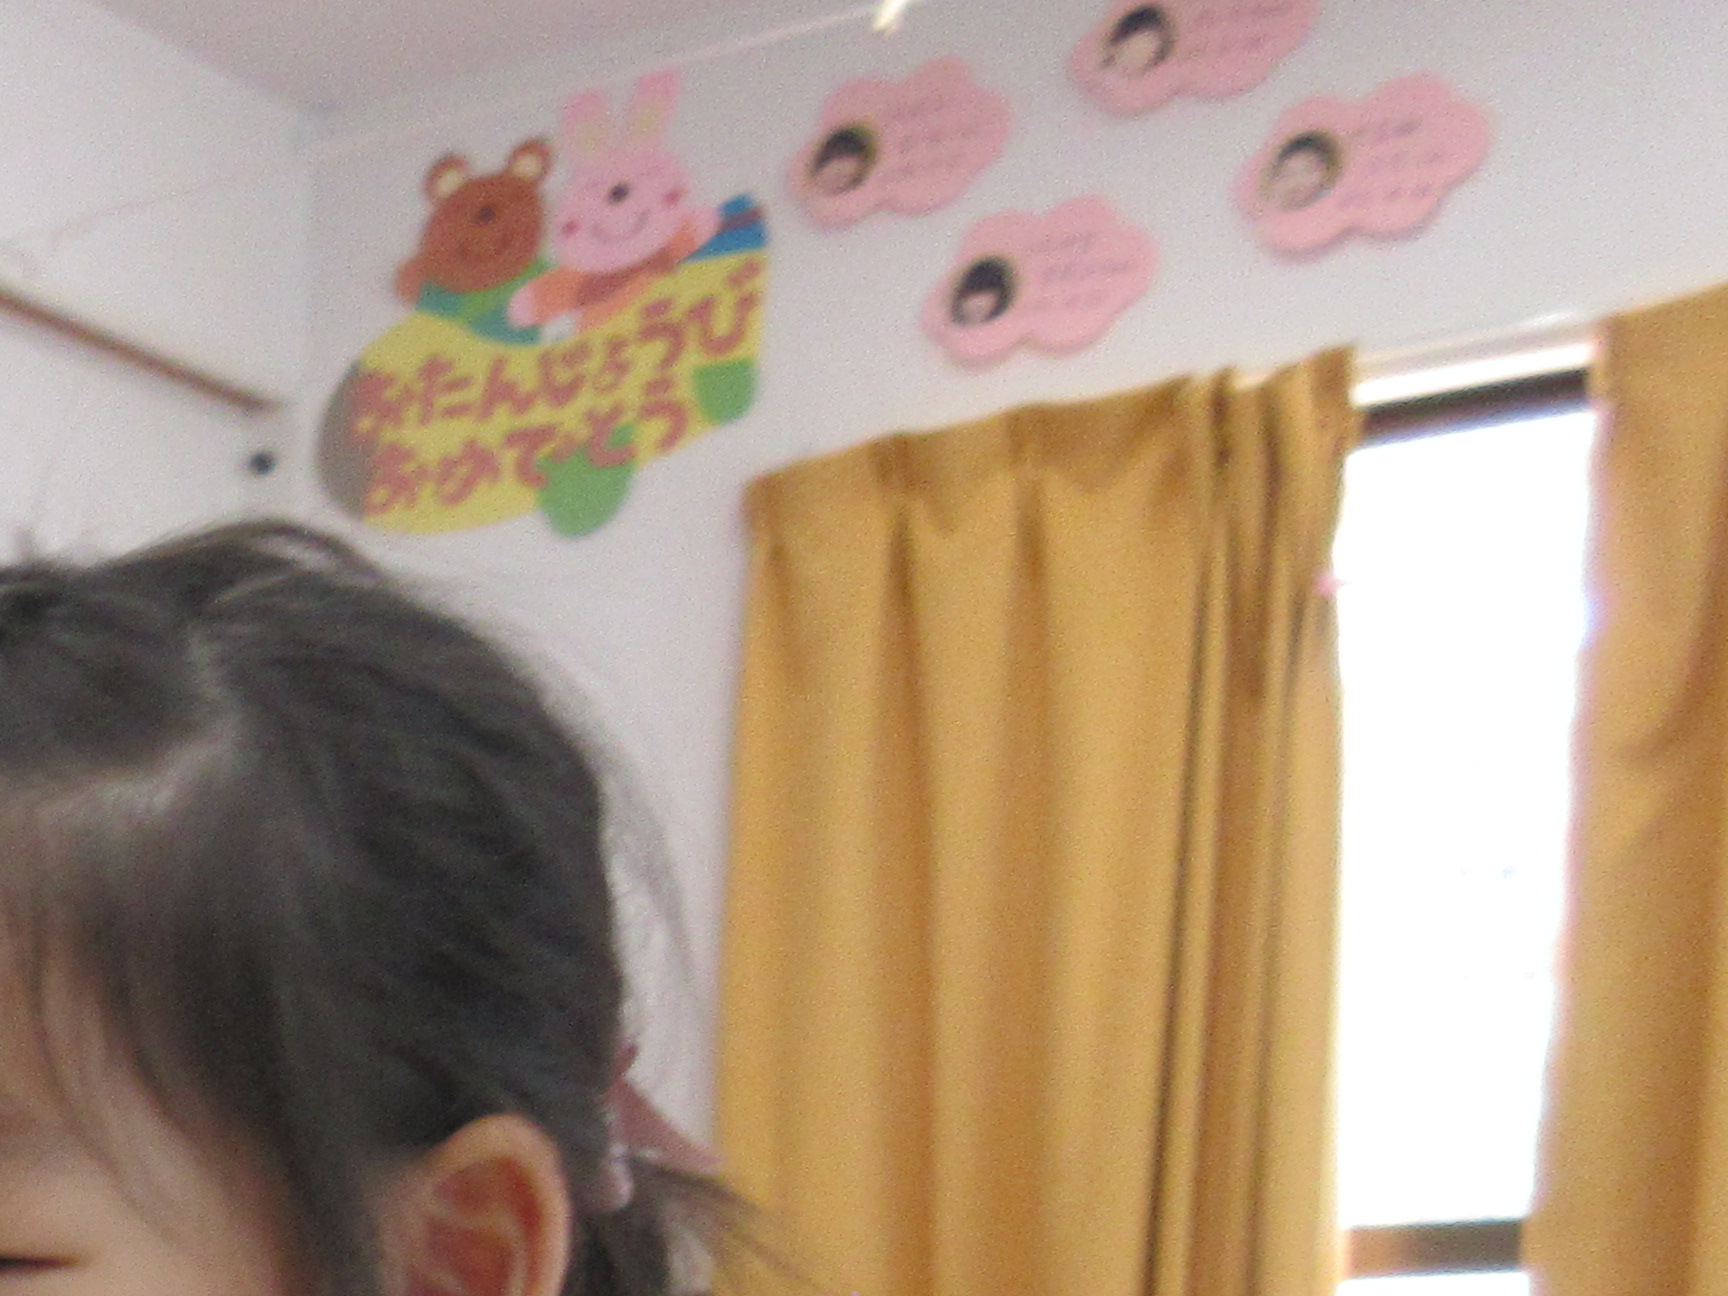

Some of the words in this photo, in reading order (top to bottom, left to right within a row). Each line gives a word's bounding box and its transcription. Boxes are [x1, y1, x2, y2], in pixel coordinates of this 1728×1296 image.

[346, 256, 766, 445] おたんじょうび
[360, 374, 690, 518] おめでとう
